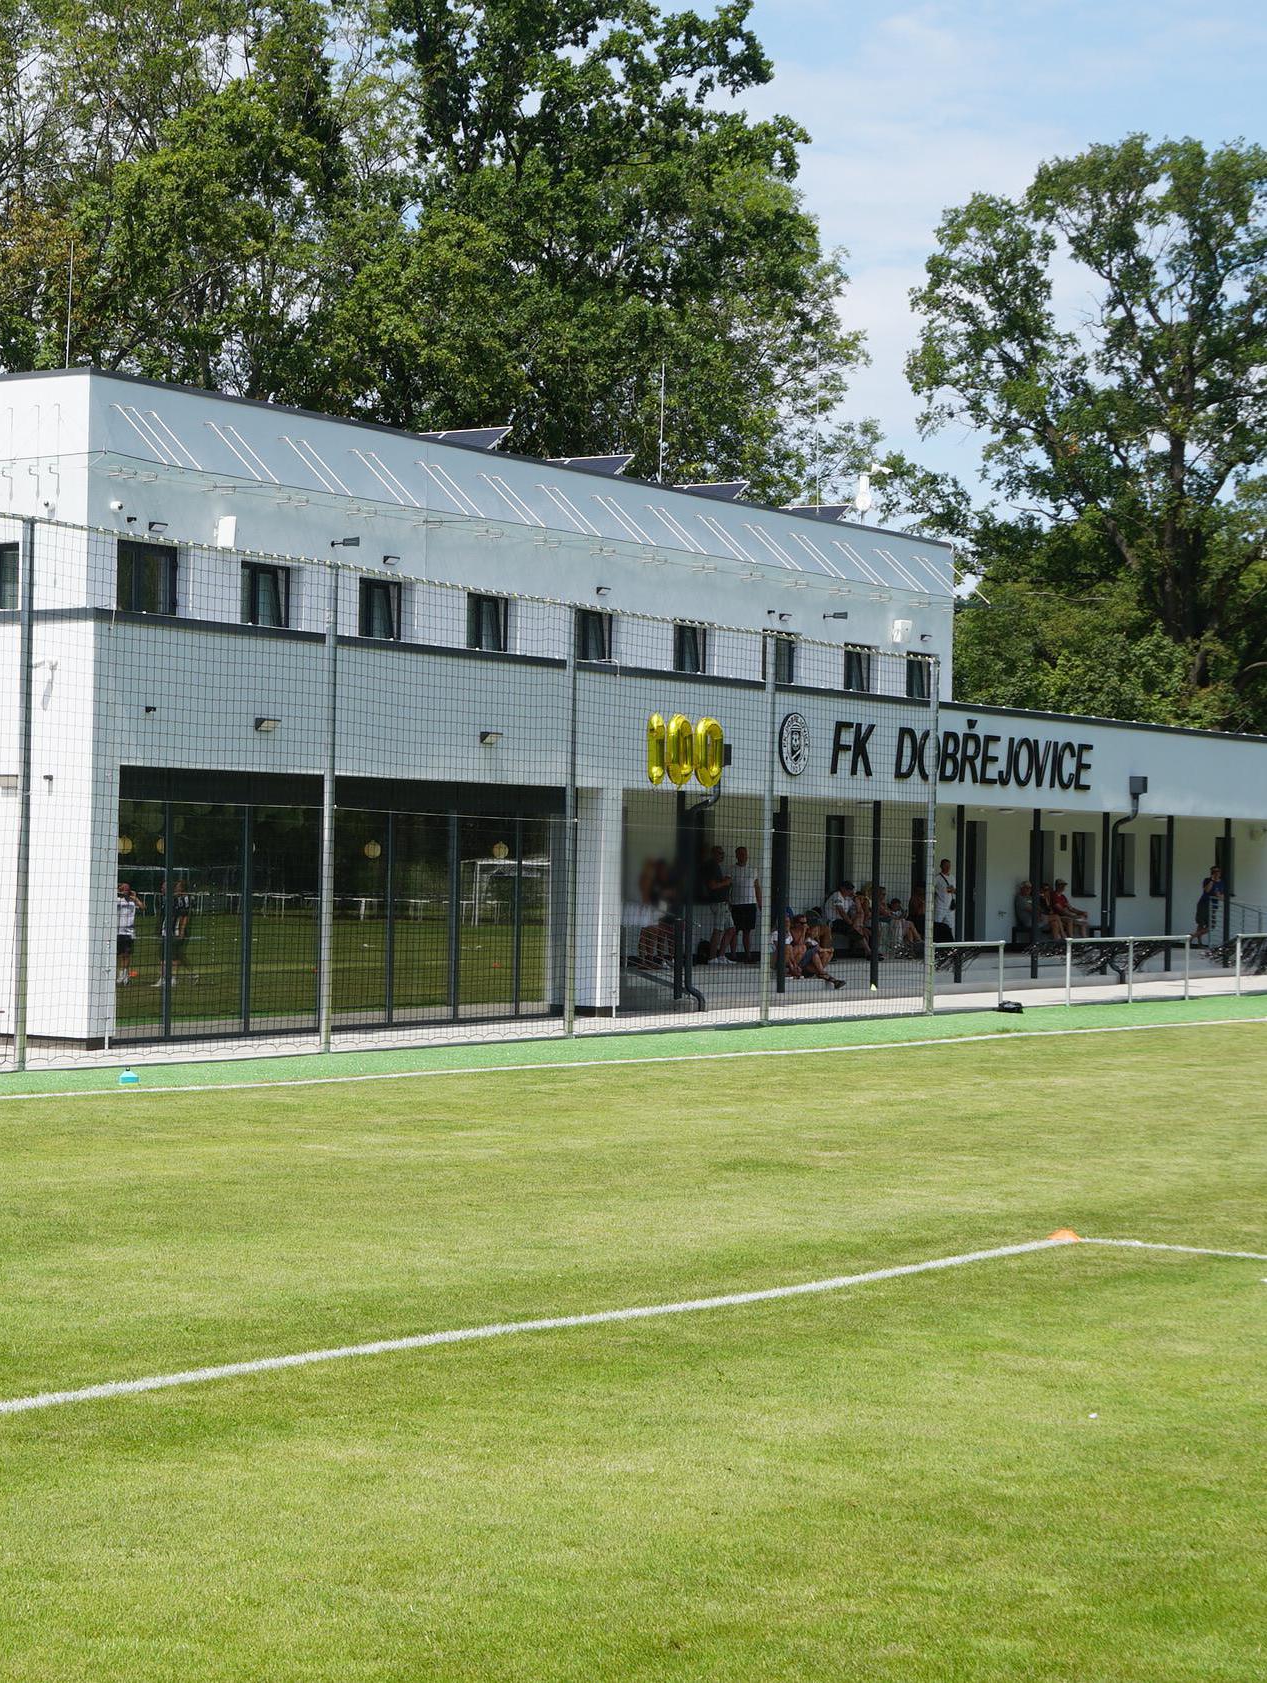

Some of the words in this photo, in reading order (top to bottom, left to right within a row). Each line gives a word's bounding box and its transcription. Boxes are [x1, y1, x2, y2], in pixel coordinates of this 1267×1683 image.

[647, 712, 724, 788] 100
[830, 720, 877, 777] FK
[894, 719, 1094, 791] DOBŘEJOVICE
